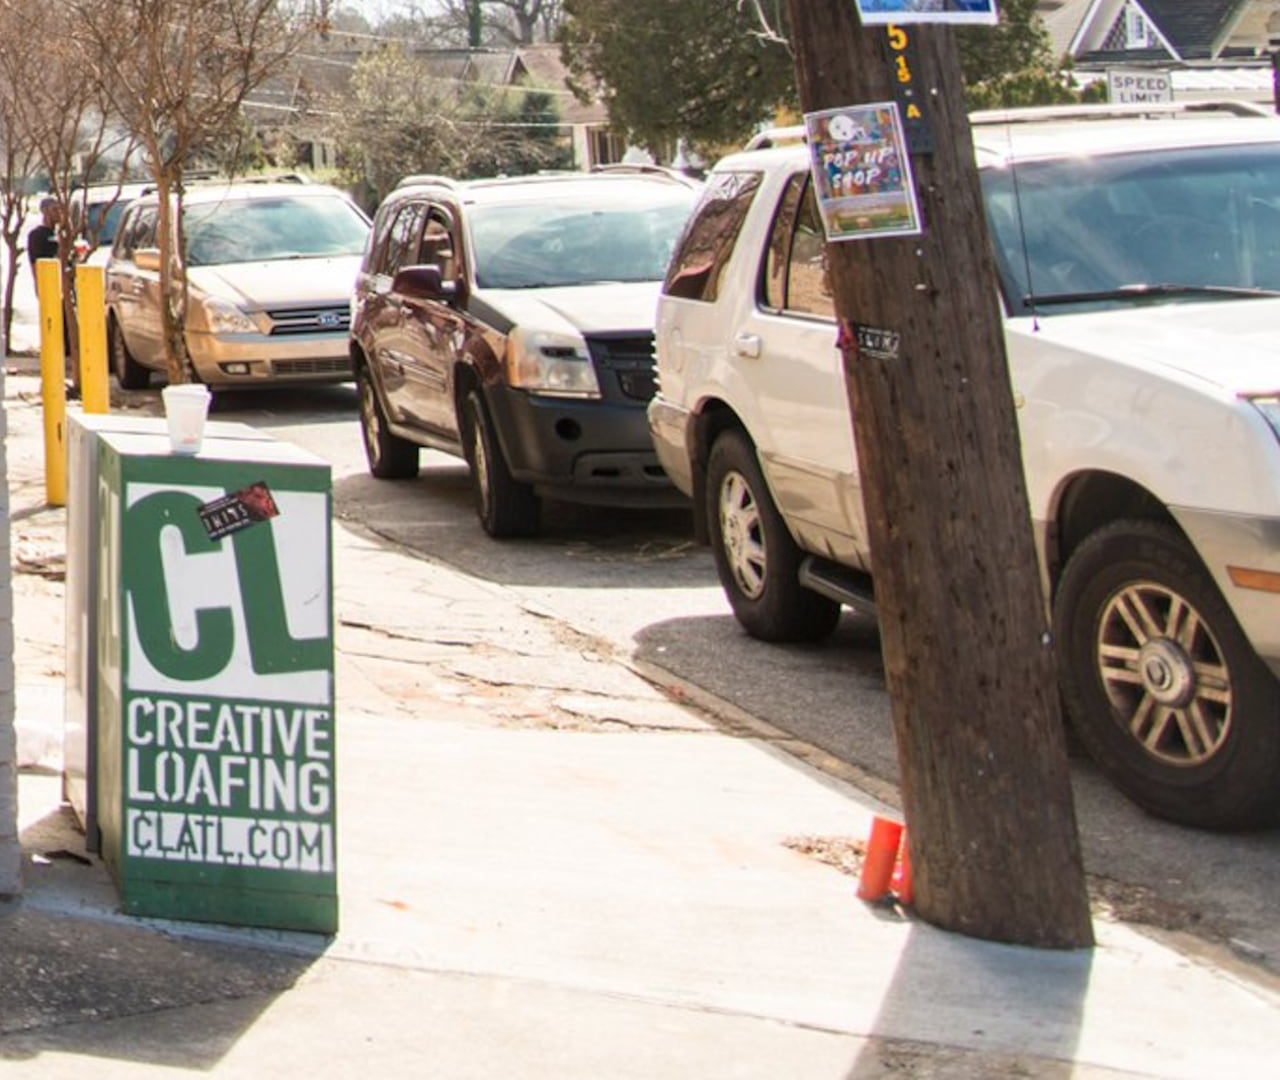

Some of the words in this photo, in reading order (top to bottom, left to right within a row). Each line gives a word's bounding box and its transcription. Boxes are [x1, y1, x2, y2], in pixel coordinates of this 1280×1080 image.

[1114, 76, 1168, 91] SPEED
[1120, 91, 1162, 104] LIMIT
[907, 104, 921, 119] A
[823, 150, 859, 170] POP
[864, 146, 895, 168] UP
[832, 167, 881, 190] SHOP
[123, 490, 330, 681] CL
[127, 696, 330, 759] CREATIVE
[128, 746, 331, 816] LOAFING
[131, 814, 325, 869] CLATL.COM
